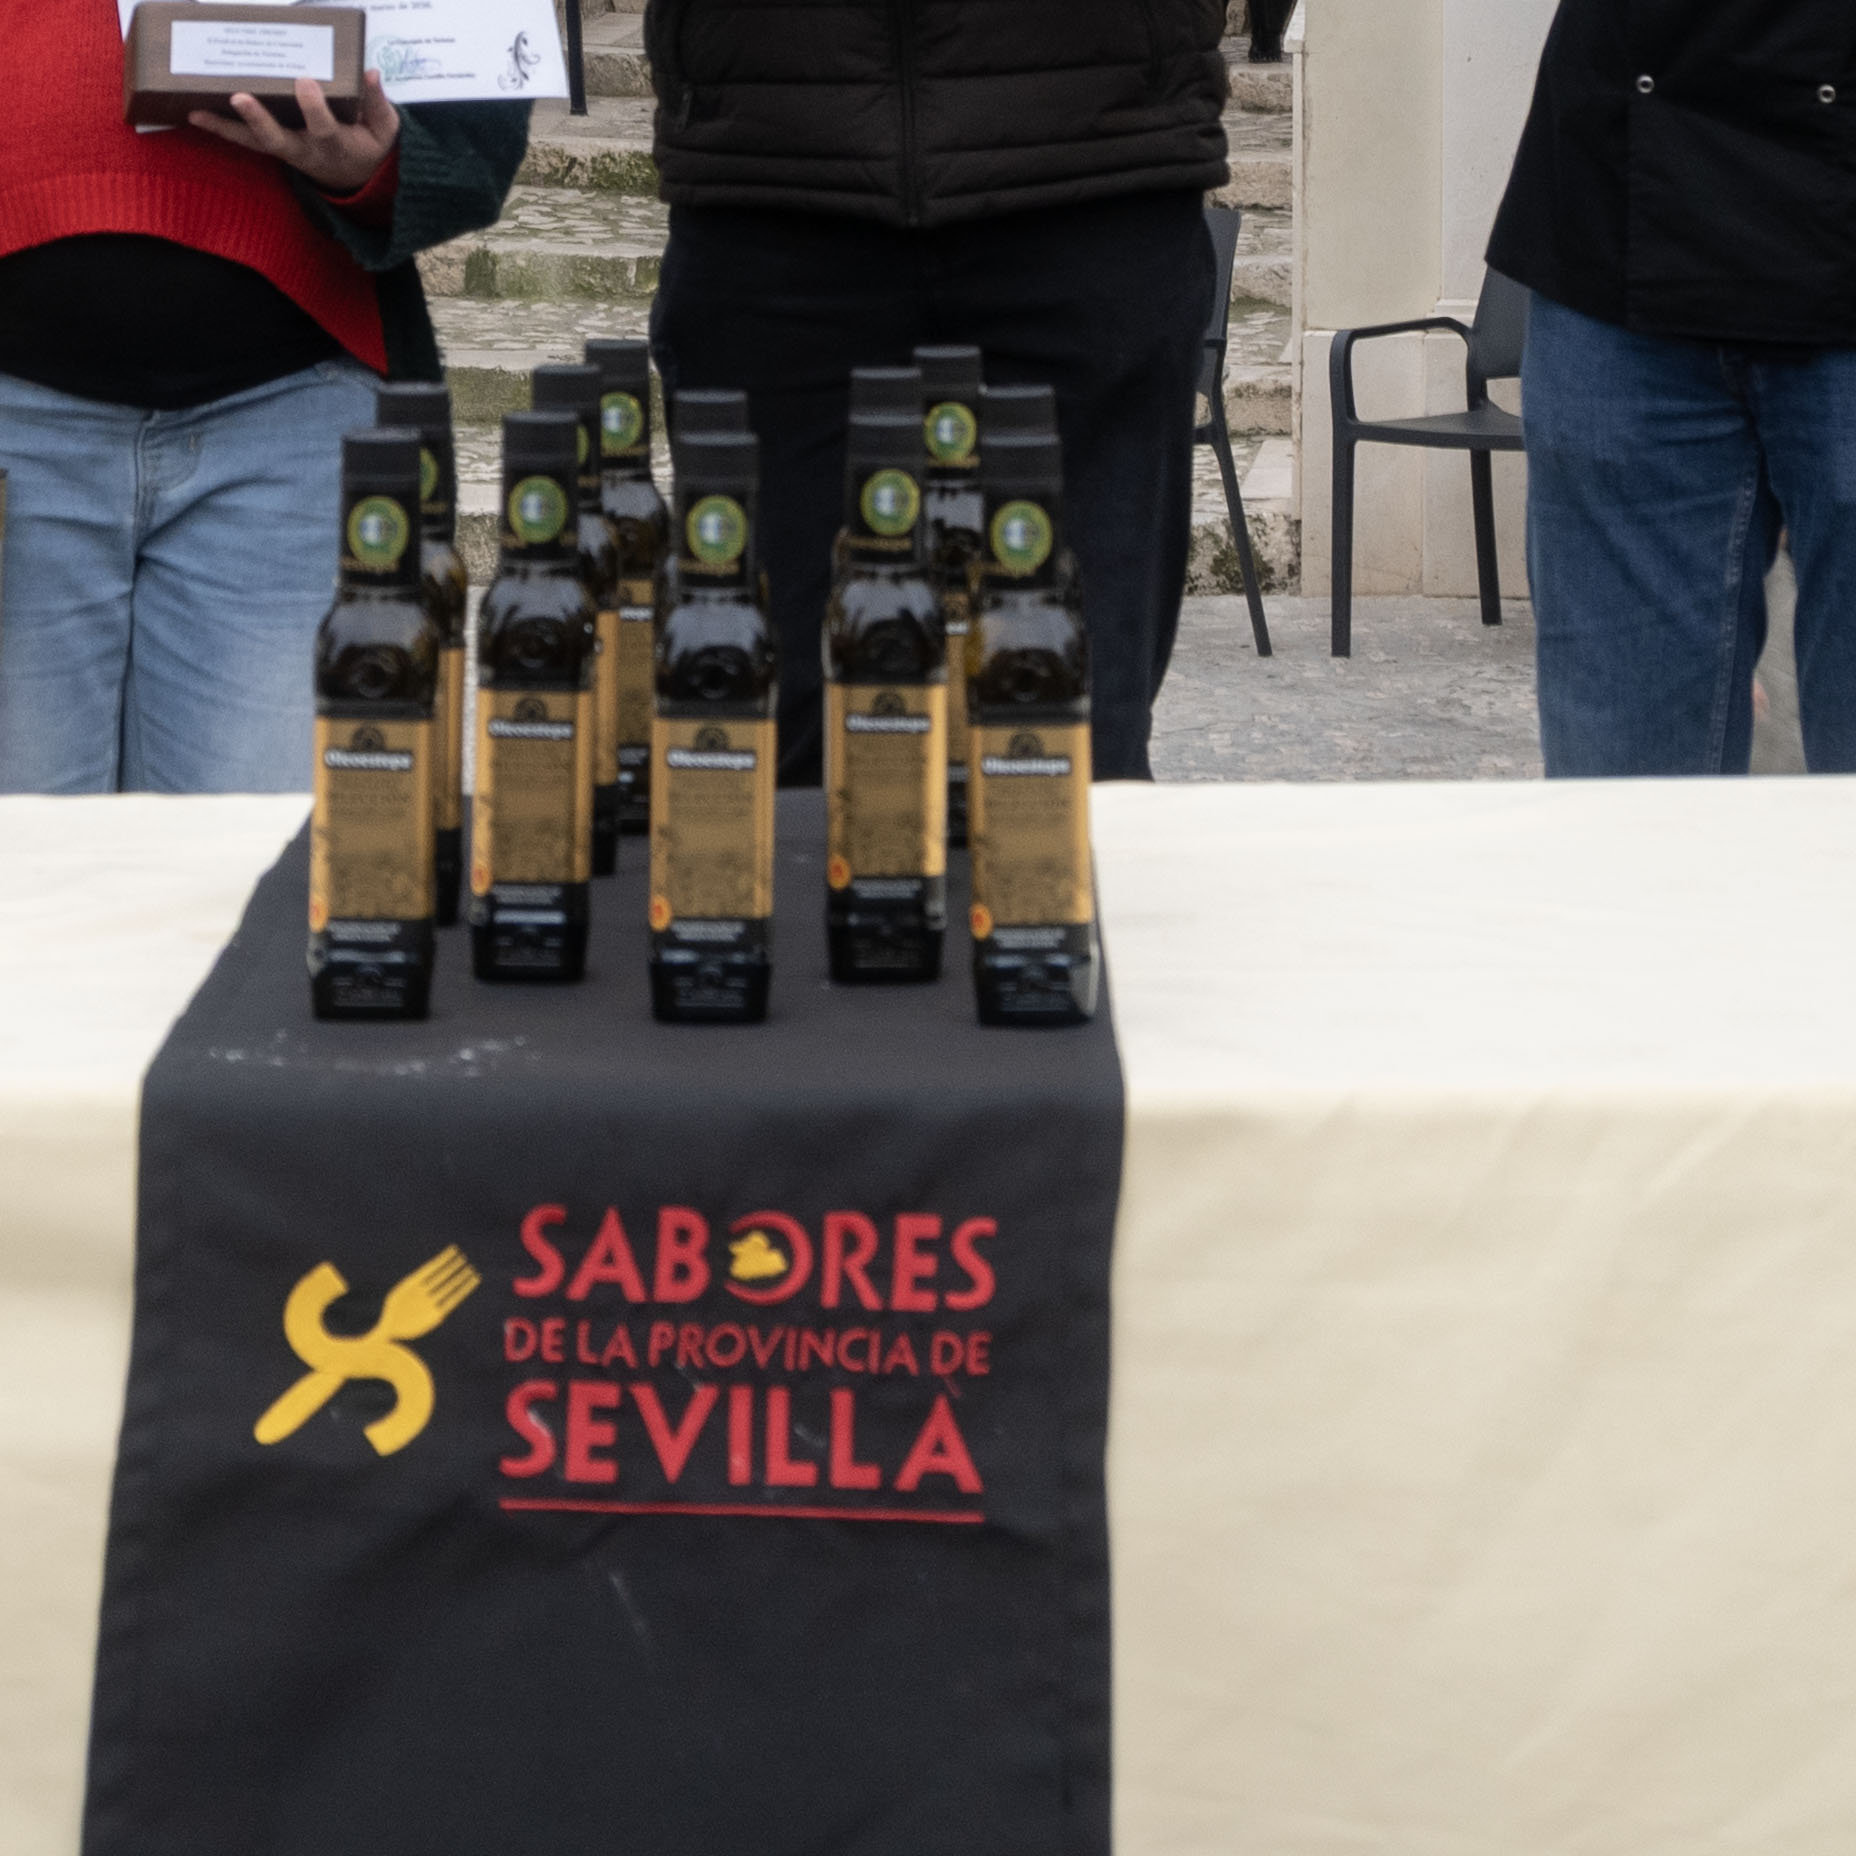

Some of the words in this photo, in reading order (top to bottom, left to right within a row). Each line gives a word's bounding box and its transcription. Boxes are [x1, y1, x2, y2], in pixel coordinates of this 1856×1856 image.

[512, 1202, 999, 1313] SABORES
[504, 1316, 567, 1364] DE
[576, 1319, 639, 1369] LA
[648, 1320, 921, 1377] PROVINCIA
[929, 1329, 993, 1377] DE
[498, 1379, 985, 1495] SEVILLA
